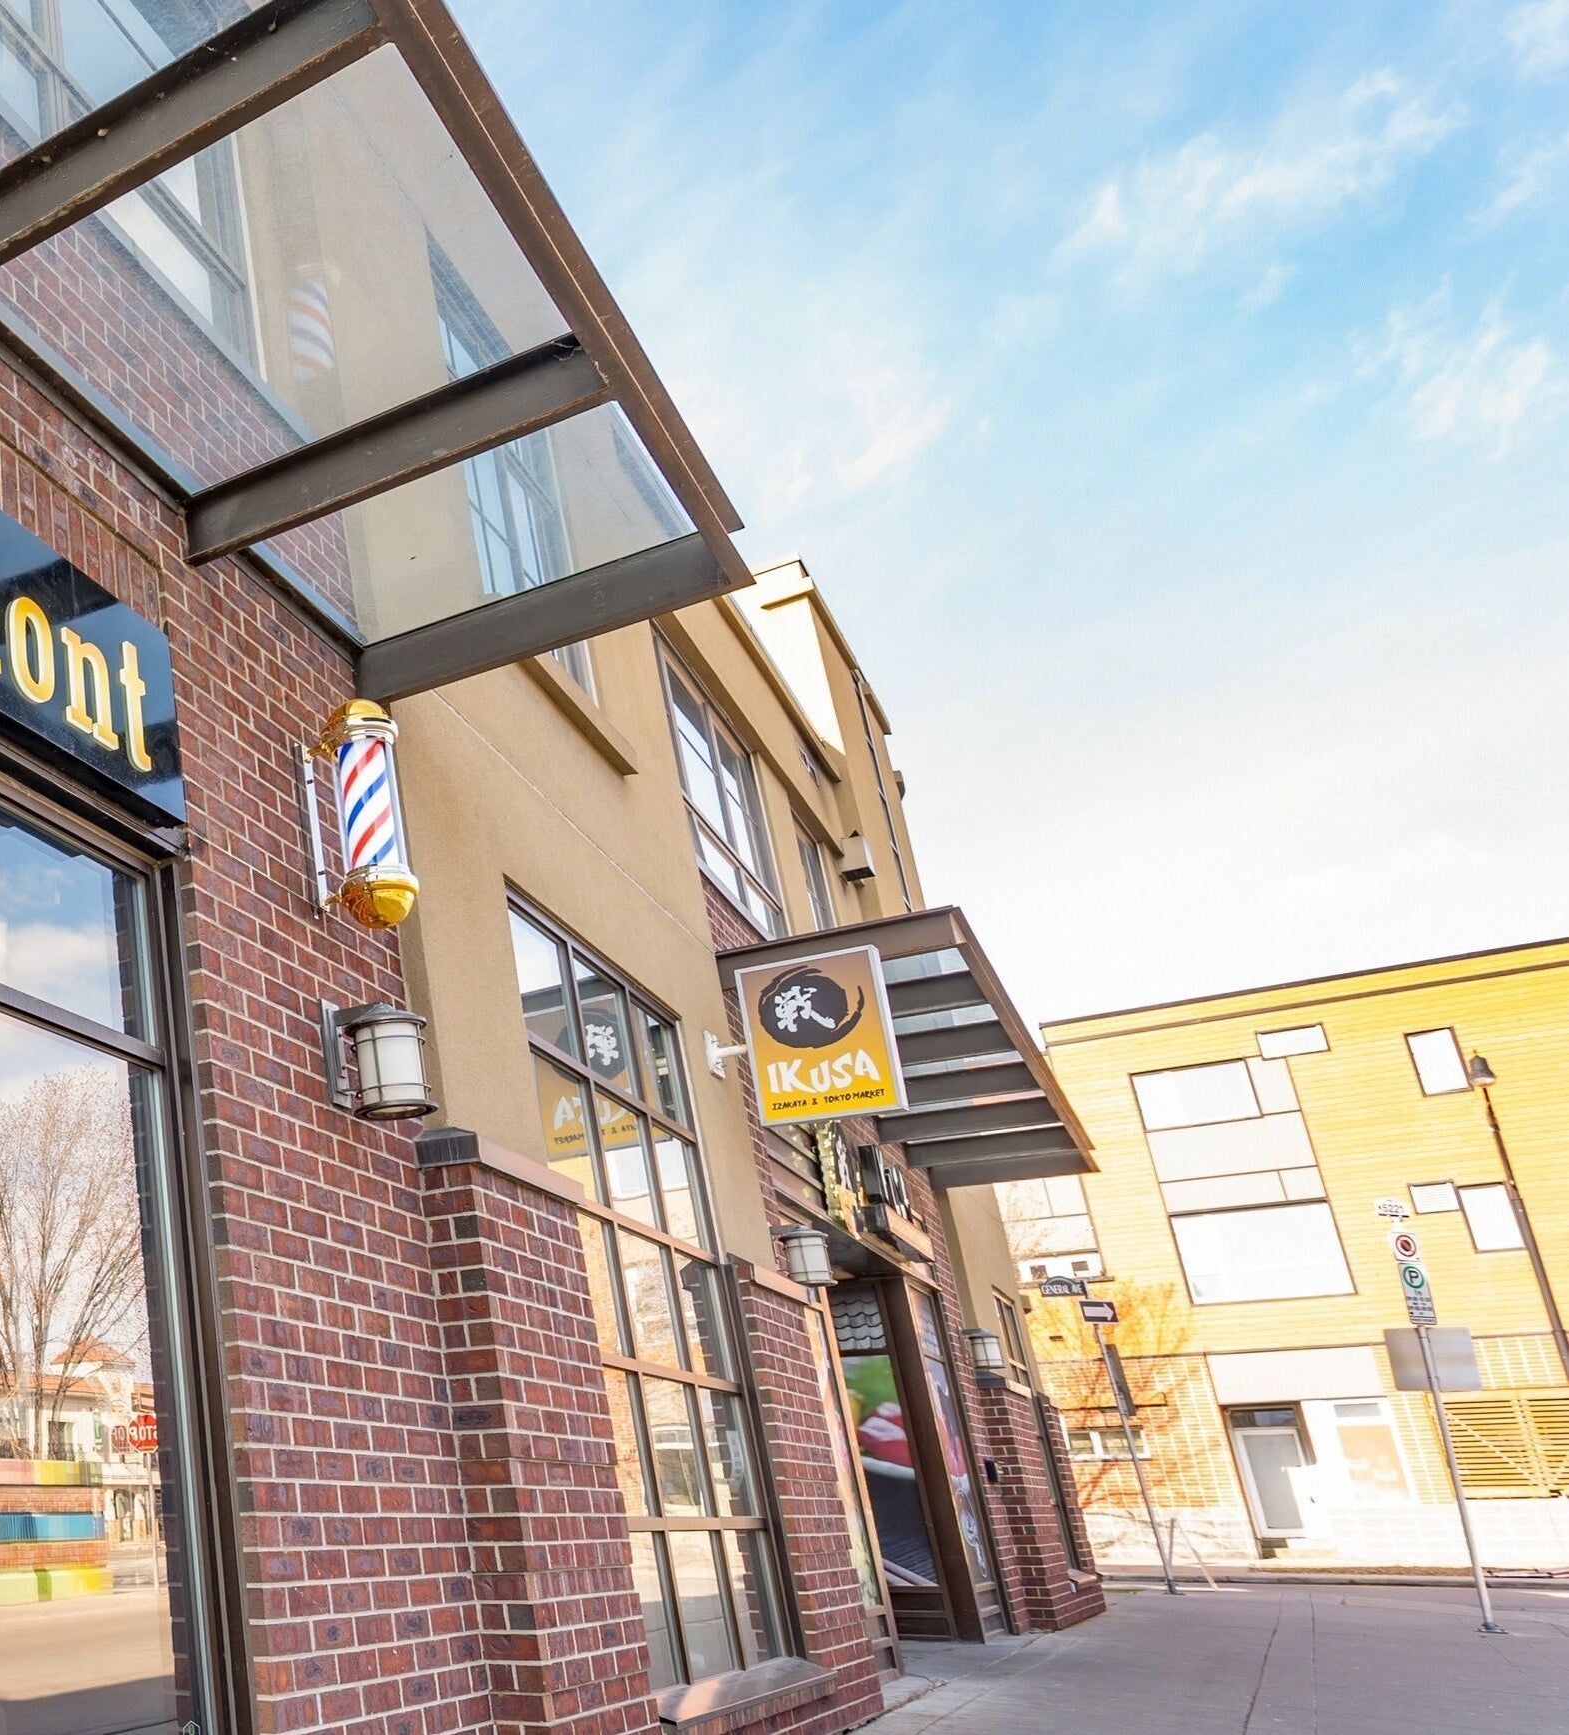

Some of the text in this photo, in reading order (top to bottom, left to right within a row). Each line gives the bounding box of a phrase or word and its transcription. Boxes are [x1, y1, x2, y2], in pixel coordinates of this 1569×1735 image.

[766, 1048, 881, 1094] IKUSA
[771, 1098, 808, 1111] IZAKAYA
[823, 1093, 851, 1104] TOKYO
[852, 1088, 885, 1099] MARKET
[1041, 1284, 1071, 1295] GENERAL
